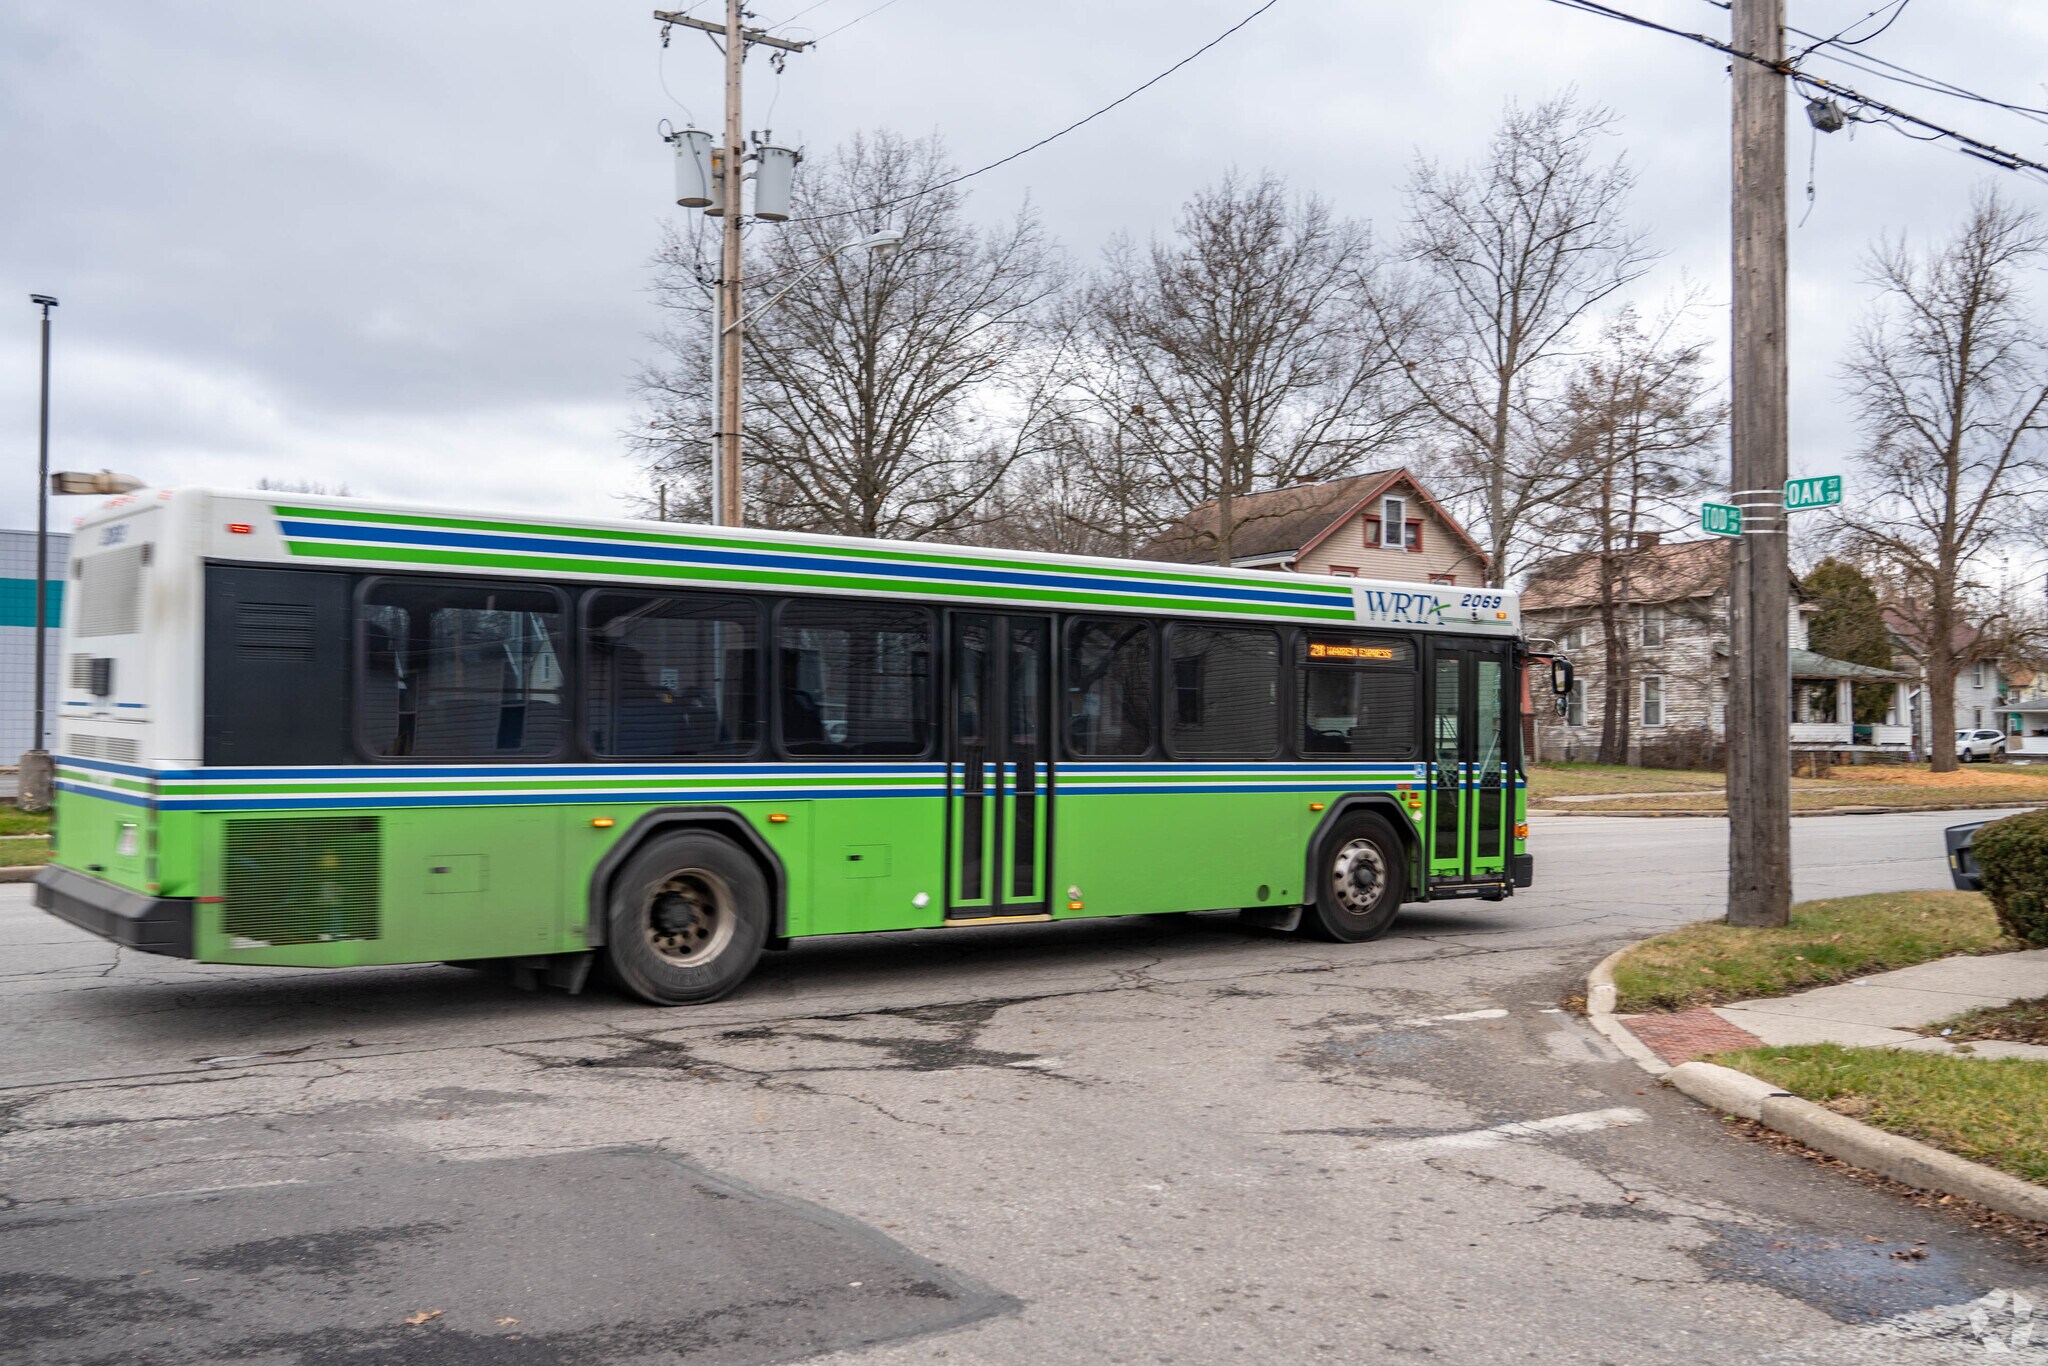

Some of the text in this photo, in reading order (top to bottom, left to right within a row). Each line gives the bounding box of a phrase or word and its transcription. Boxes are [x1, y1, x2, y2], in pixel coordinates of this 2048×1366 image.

[1788, 480, 1824, 506] OAK
[1703, 506, 1727, 530] TOD
[1365, 590, 1446, 625] WRTA
[1460, 593, 1502, 609] 2069
